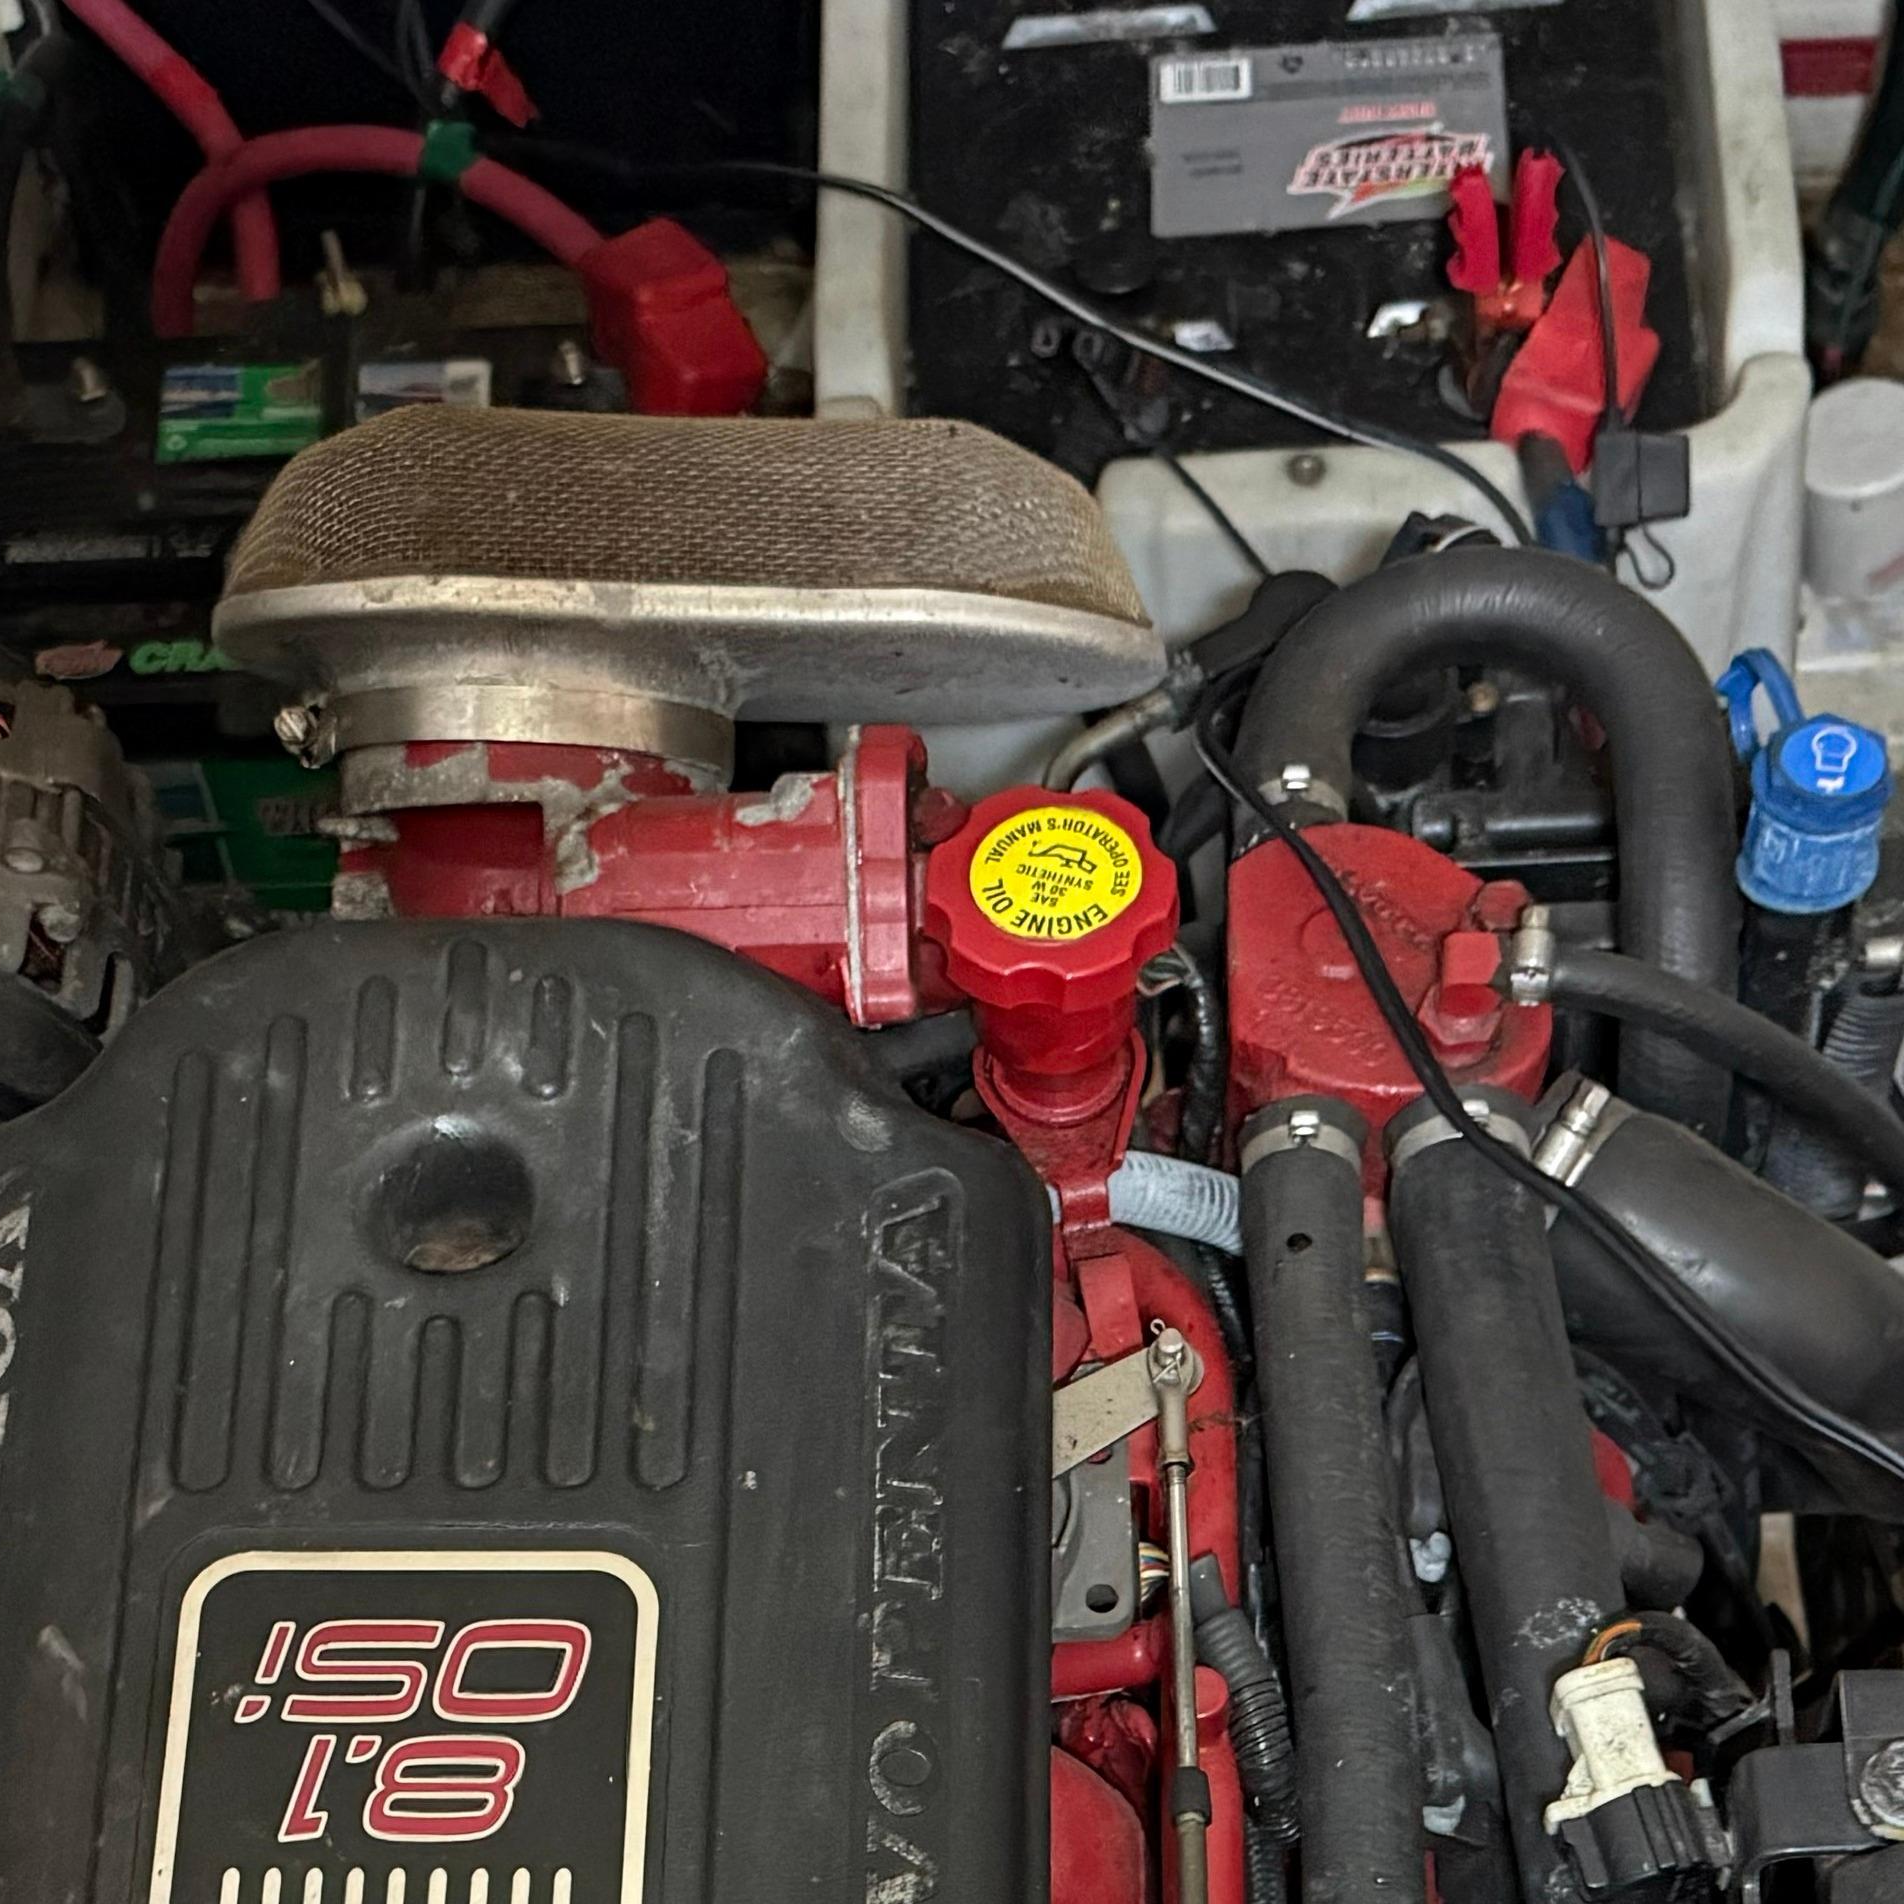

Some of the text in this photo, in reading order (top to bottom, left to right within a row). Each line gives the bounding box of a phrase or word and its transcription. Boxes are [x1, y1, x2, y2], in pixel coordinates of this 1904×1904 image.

[985, 817, 1130, 897] SEE OPERATOR'S MANUAL
[1016, 864, 1094, 890] SYNTHETIC
[982, 878, 1109, 937] ENGINE OIL
[1031, 892, 1059, 907] SAE
[1032, 880, 1068, 897] 30 W
[278, 1734, 527, 1843] 8.1
